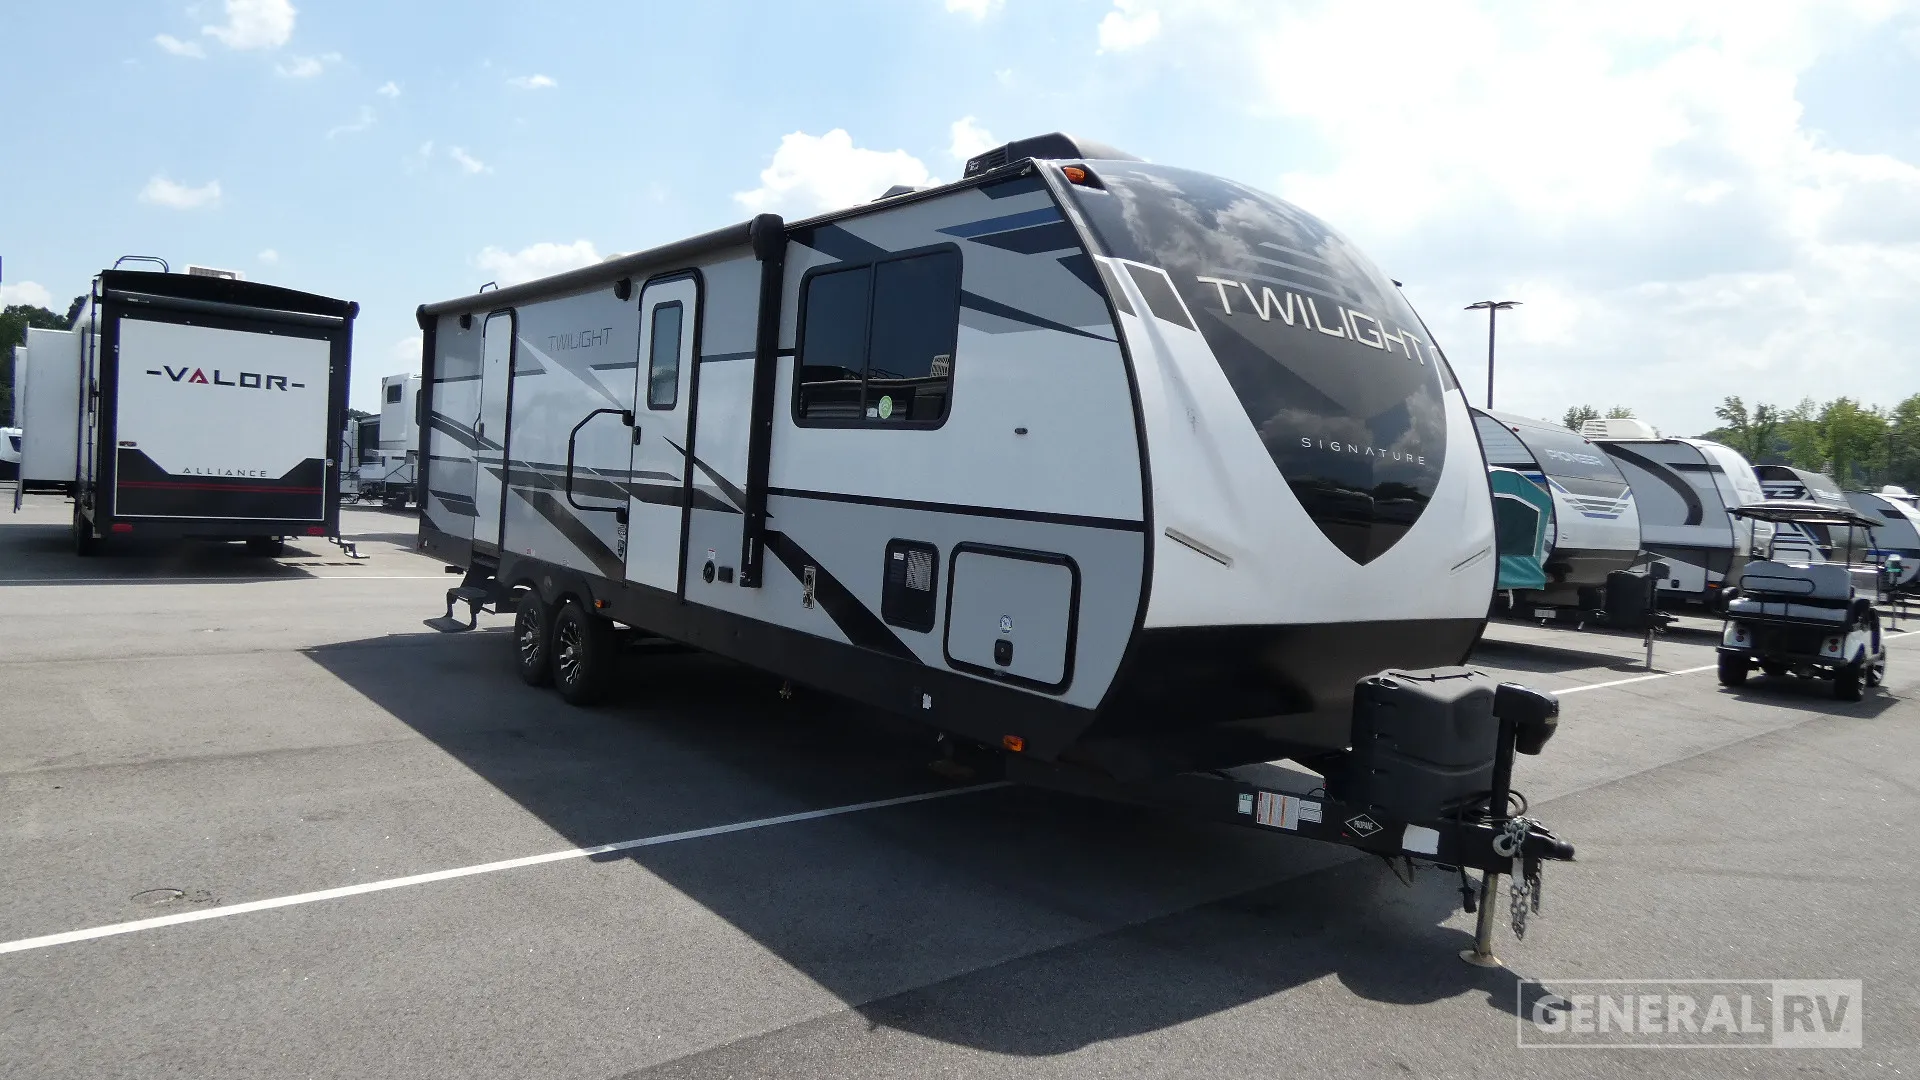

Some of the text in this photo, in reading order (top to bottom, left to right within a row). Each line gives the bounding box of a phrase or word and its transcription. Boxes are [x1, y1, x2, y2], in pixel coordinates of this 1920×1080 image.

[1196, 275, 1425, 366] TWILIGHT
[547, 327, 613, 351] TWILIGHT
[1301, 437, 1426, 466] SIGNATURE
[182, 467, 268, 478] ALLIANCE
[1353, 820, 1374, 831] PROPANE
